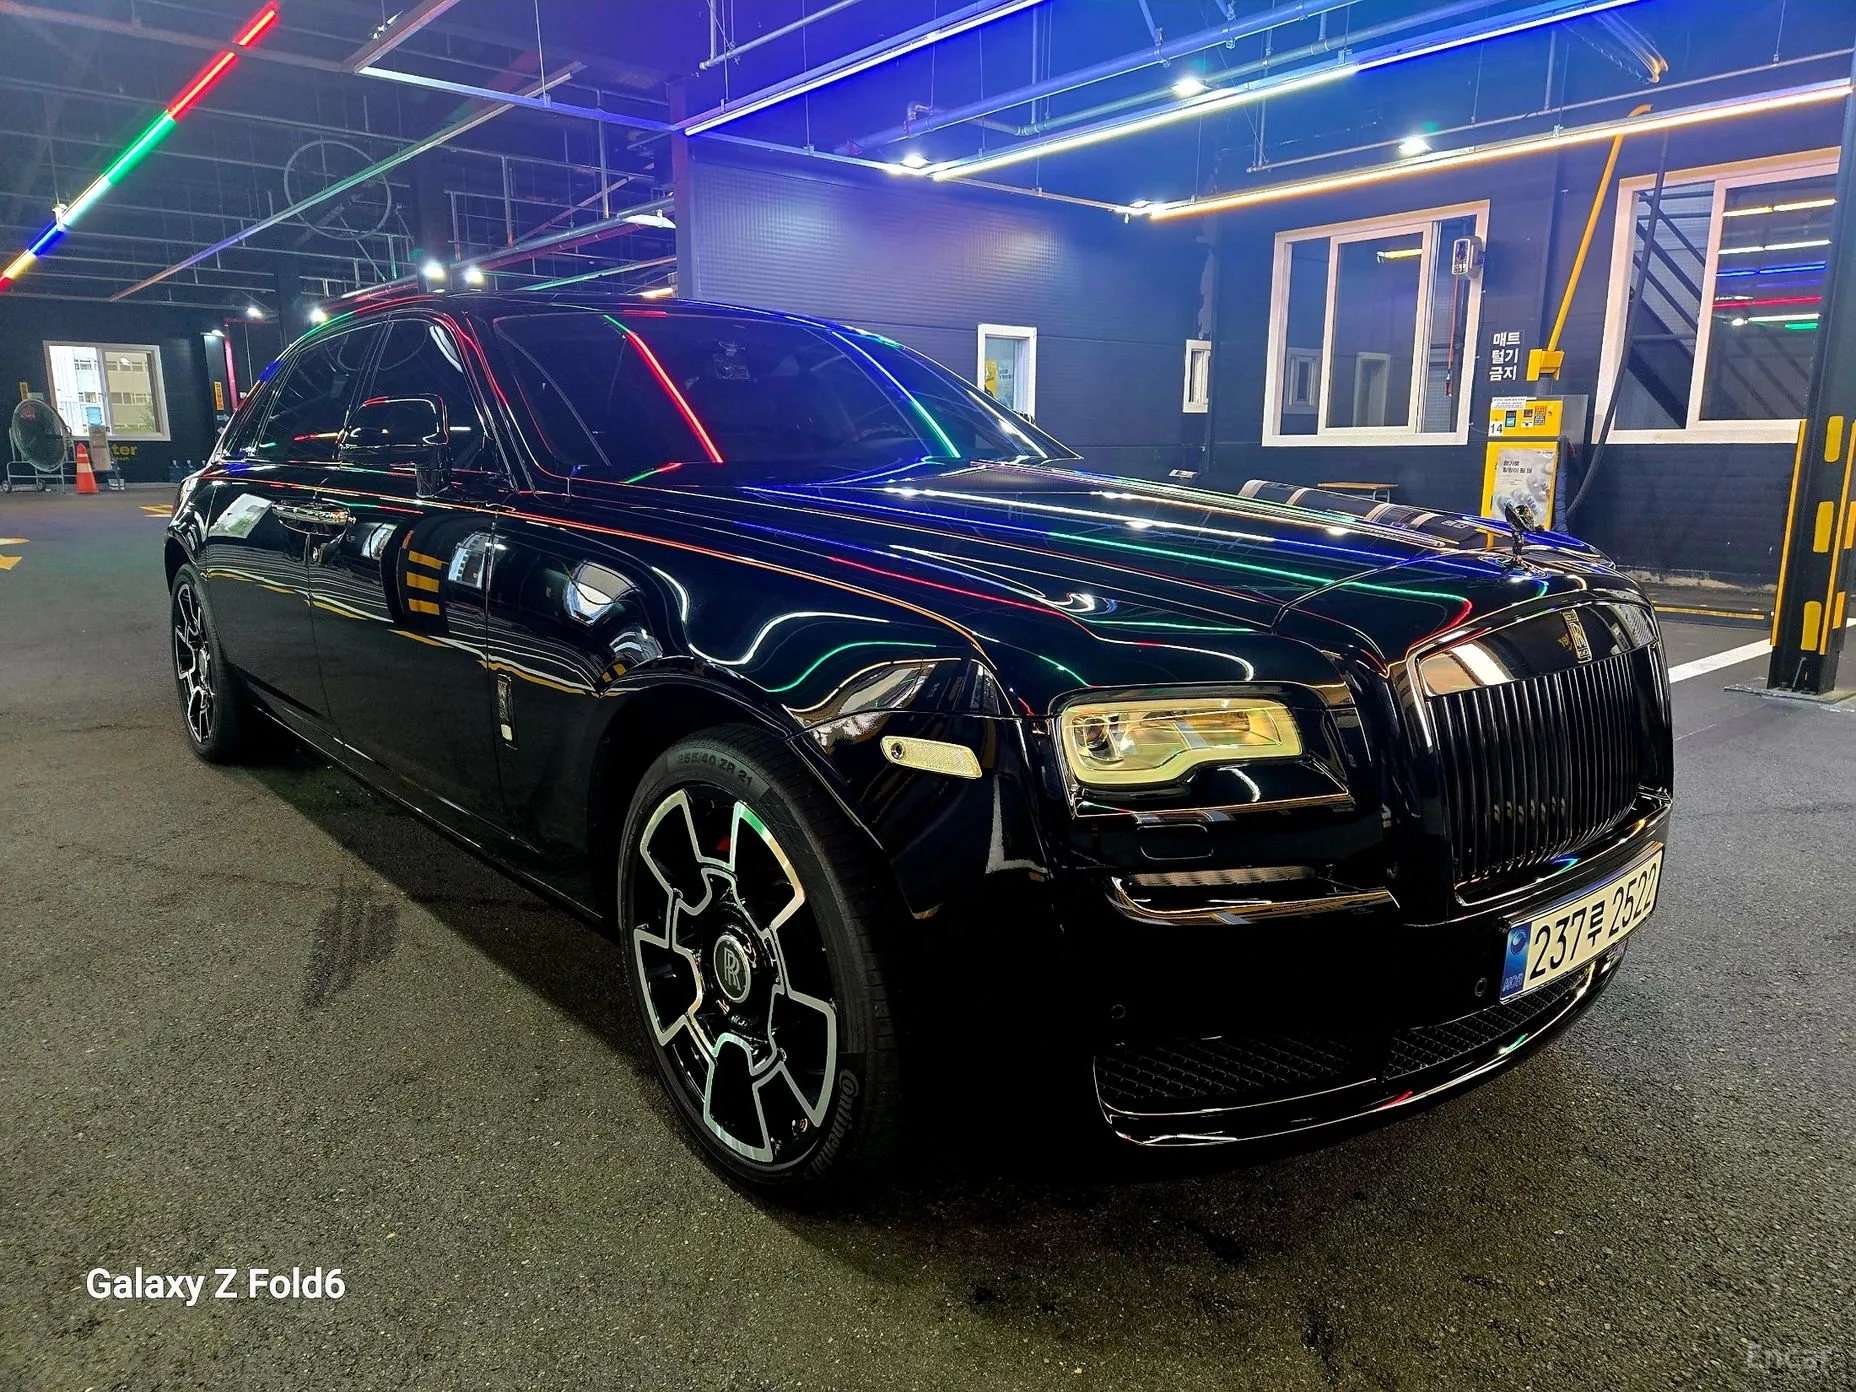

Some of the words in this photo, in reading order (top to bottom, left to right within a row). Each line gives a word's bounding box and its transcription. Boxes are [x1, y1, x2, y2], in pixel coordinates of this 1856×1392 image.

[1493, 332, 1520, 347] 매트
[1492, 348, 1519, 364] 털기
[1489, 365, 1517, 382] 금지
[1490, 423, 1503, 434] 14
[677, 751, 717, 767] 255/40
[719, 758, 737, 775] ZR
[737, 769, 754, 786] 21
[1529, 900, 1605, 981] 237루
[1608, 862, 1657, 939] 2522
